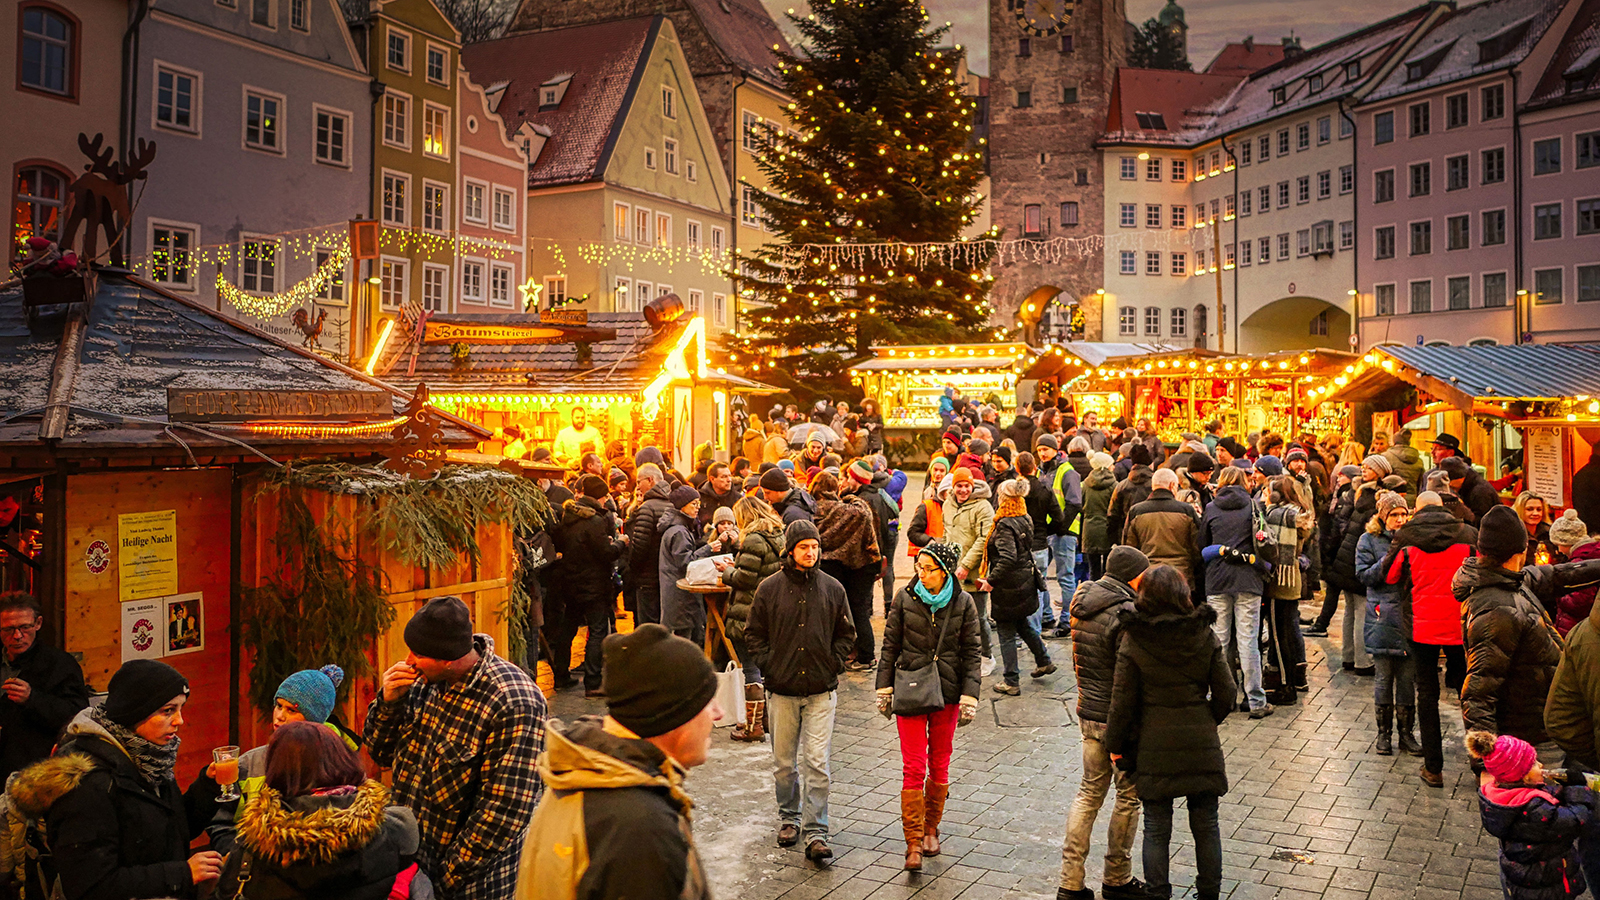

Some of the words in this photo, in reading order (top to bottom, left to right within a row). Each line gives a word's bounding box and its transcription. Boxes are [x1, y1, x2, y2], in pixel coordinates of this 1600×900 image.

[434, 325, 533, 338] Baumstriezel
[184, 392, 380, 416] FEUERZANGENBOWLE
[122, 536, 149, 548] Heilige
[150, 533, 173, 544] Nacht
